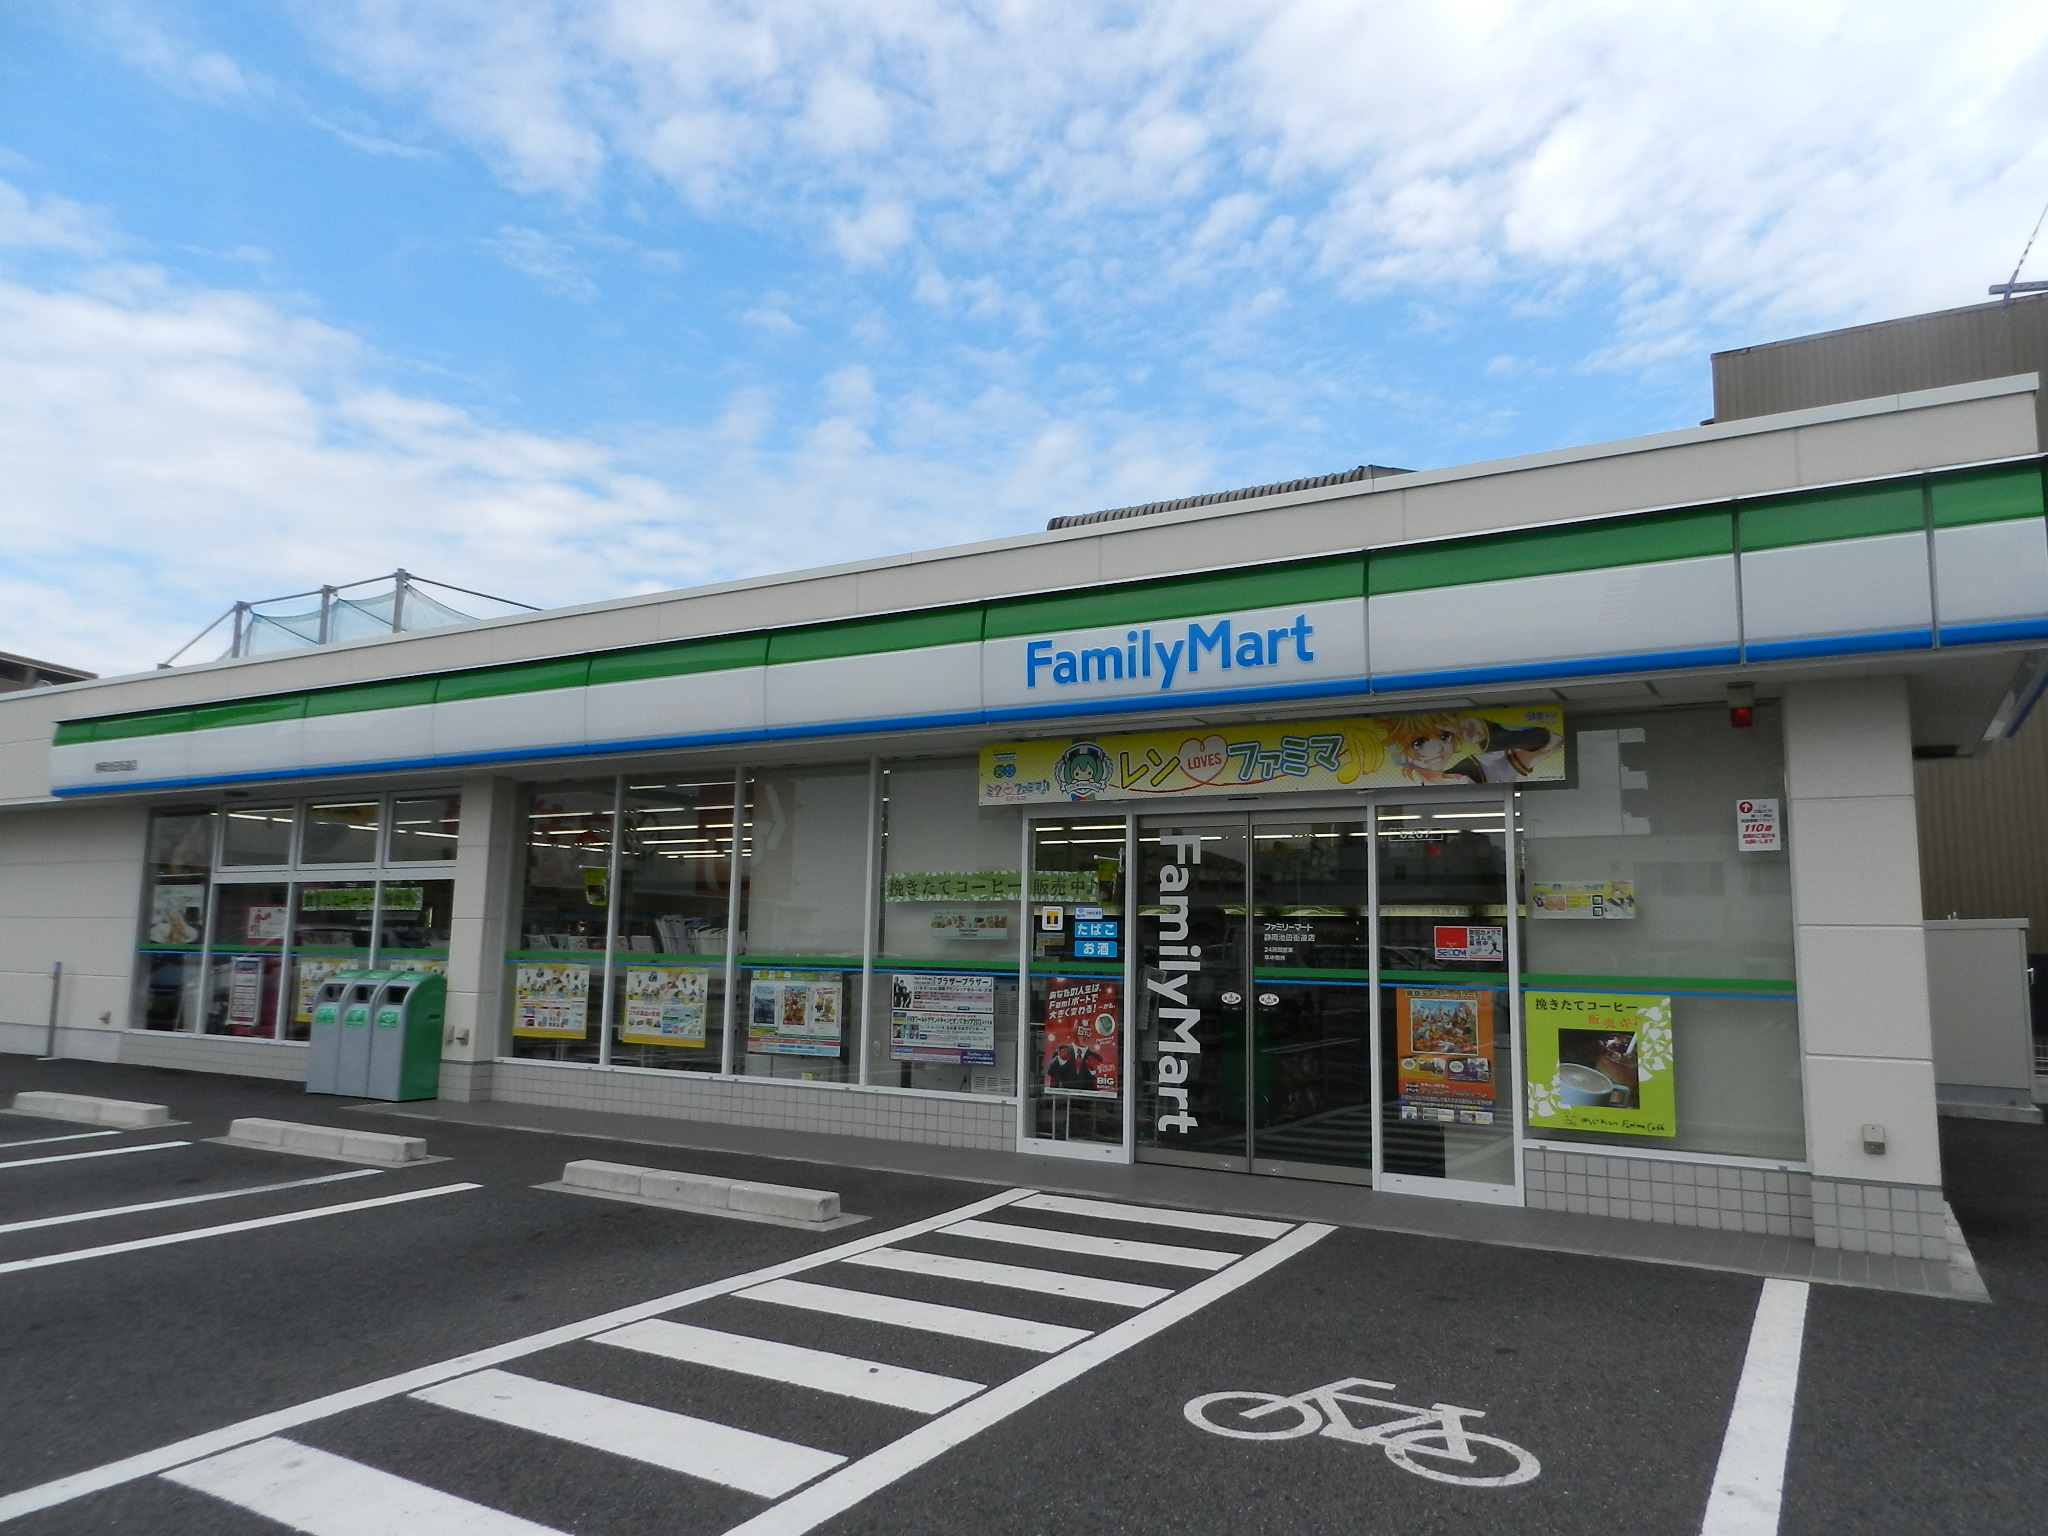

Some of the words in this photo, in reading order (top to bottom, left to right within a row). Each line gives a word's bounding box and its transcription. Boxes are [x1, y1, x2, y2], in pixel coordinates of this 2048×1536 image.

[1026, 614, 1314, 690] FamilyMart
[1119, 749, 1181, 790] レン
[1187, 753, 1223, 771] LOVES
[1226, 734, 1345, 782] ファミマ
[889, 878, 1022, 898] 挽きたてコーヒー
[1032, 878, 1085, 897] 販売中
[1077, 923, 1115, 936] たばこ
[1263, 923, 1314, 932] ファミリーマート
[1263, 933, 1316, 942] 静岡池田街道店
[1083, 942, 1110, 957] お酒
[1436, 948, 1467, 957] SECOM
[1146, 835, 1201, 1134] FamilyMart
[1535, 998, 1638, 1013] 挽きたてコーヒー
[1588, 1014, 1631, 1029] 販売中
[1096, 1076, 1115, 1085] BIG
